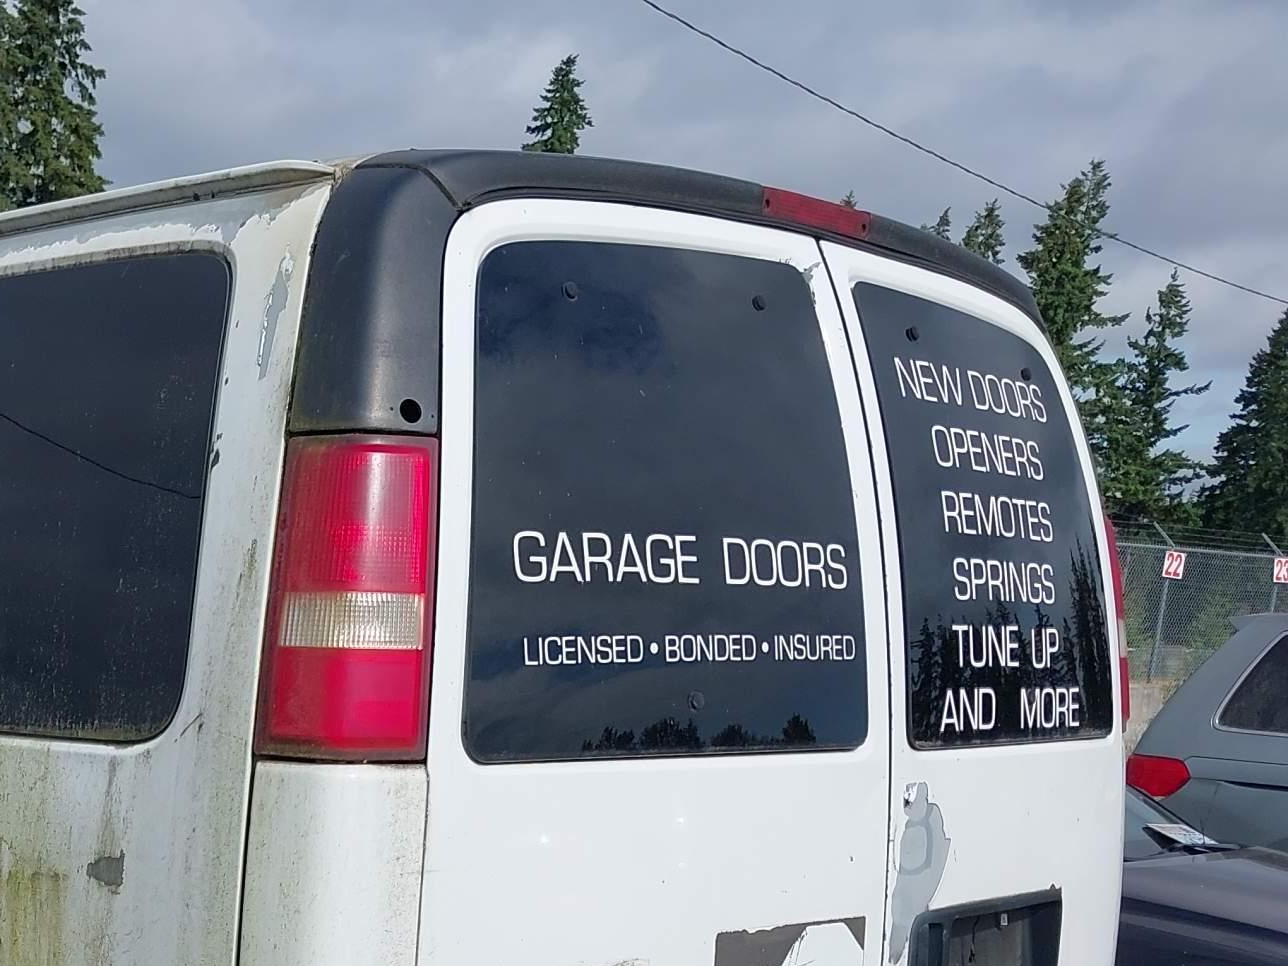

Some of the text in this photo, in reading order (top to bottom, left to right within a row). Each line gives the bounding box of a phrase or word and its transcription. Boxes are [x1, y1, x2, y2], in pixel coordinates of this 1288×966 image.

[893, 356, 1047, 423] NEW DOORS
[931, 424, 1044, 481] OPENERS
[941, 490, 1054, 543] REMOTES
[513, 530, 848, 590] GARAGE DOORS
[952, 557, 1056, 605] SPRINGS
[1164, 552, 1182, 578] 22
[523, 634, 856, 666] LICENSED BONDED INSURED
[951, 624, 1059, 669] TUNE UP
[940, 686, 1080, 733] AND MORE
